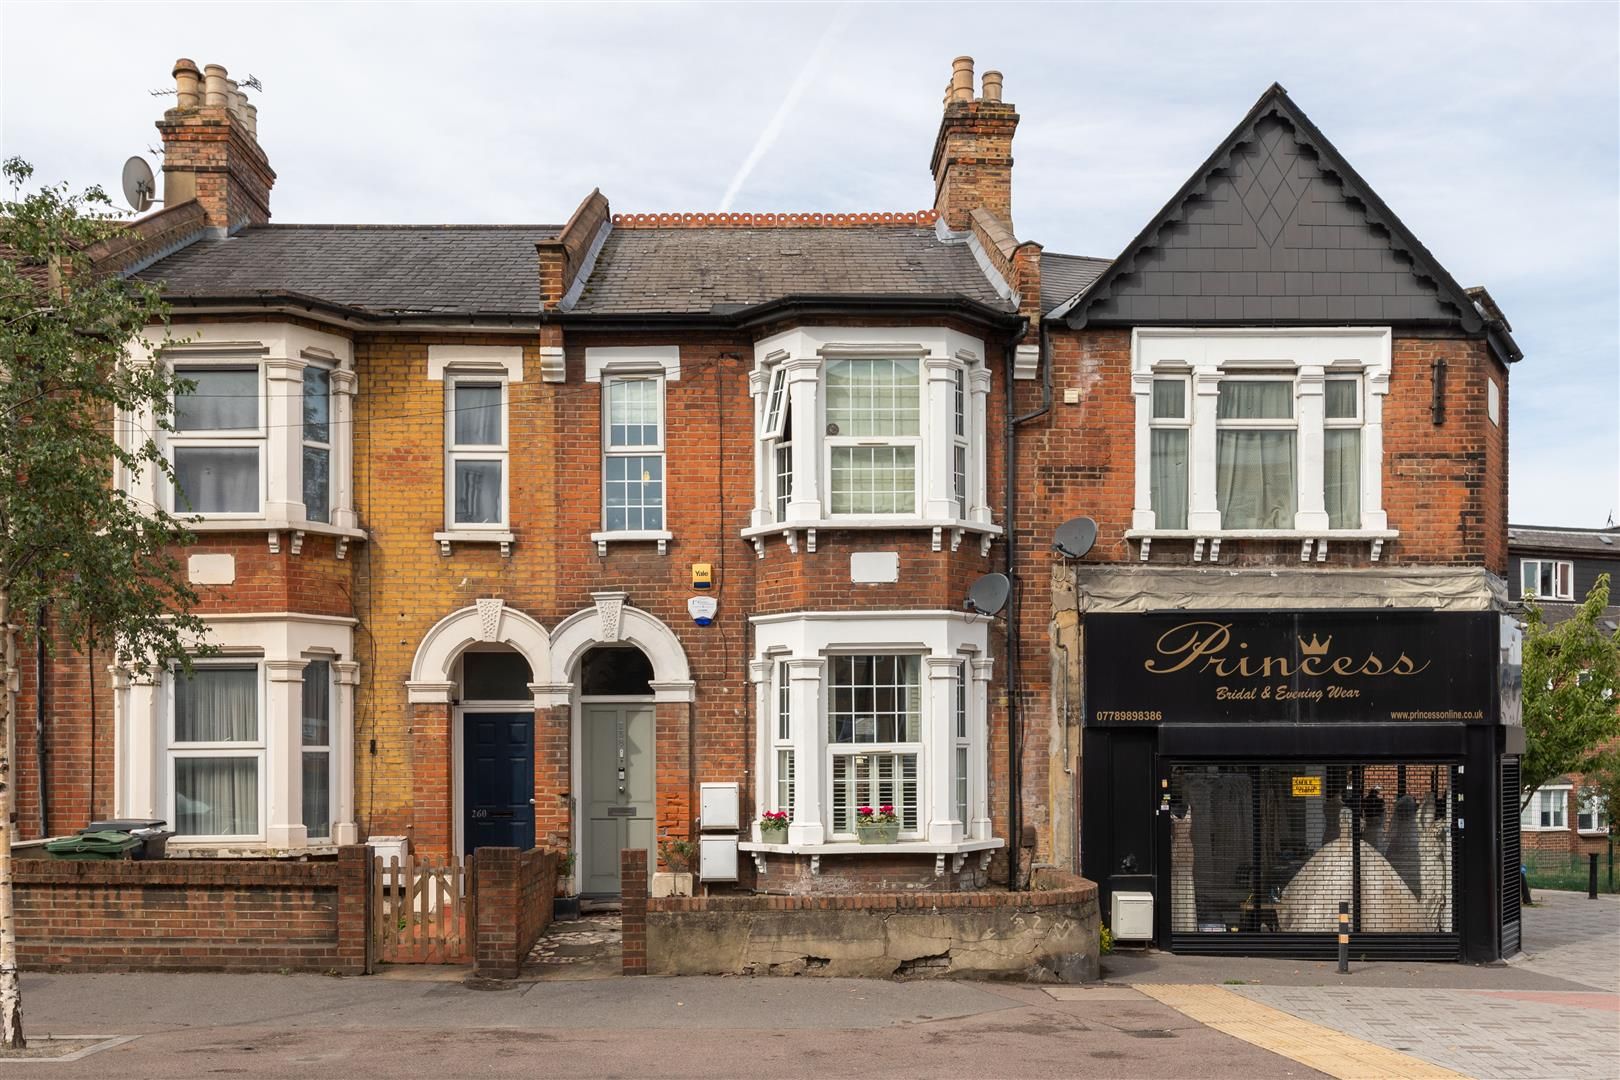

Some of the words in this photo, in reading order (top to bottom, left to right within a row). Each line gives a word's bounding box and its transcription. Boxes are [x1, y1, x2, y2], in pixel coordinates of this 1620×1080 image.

[1144, 621, 1431, 677] Princess
[1216, 686, 1257, 700] Bridal
[1261, 686, 1271, 699] &
[1275, 685, 1324, 702] Evening
[1327, 686, 1361, 699] Wear
[1096, 711, 1162, 721] 07789898386
[1390, 709, 1484, 721] www.princessonline.co.uk
[471, 809, 487, 818] 260
